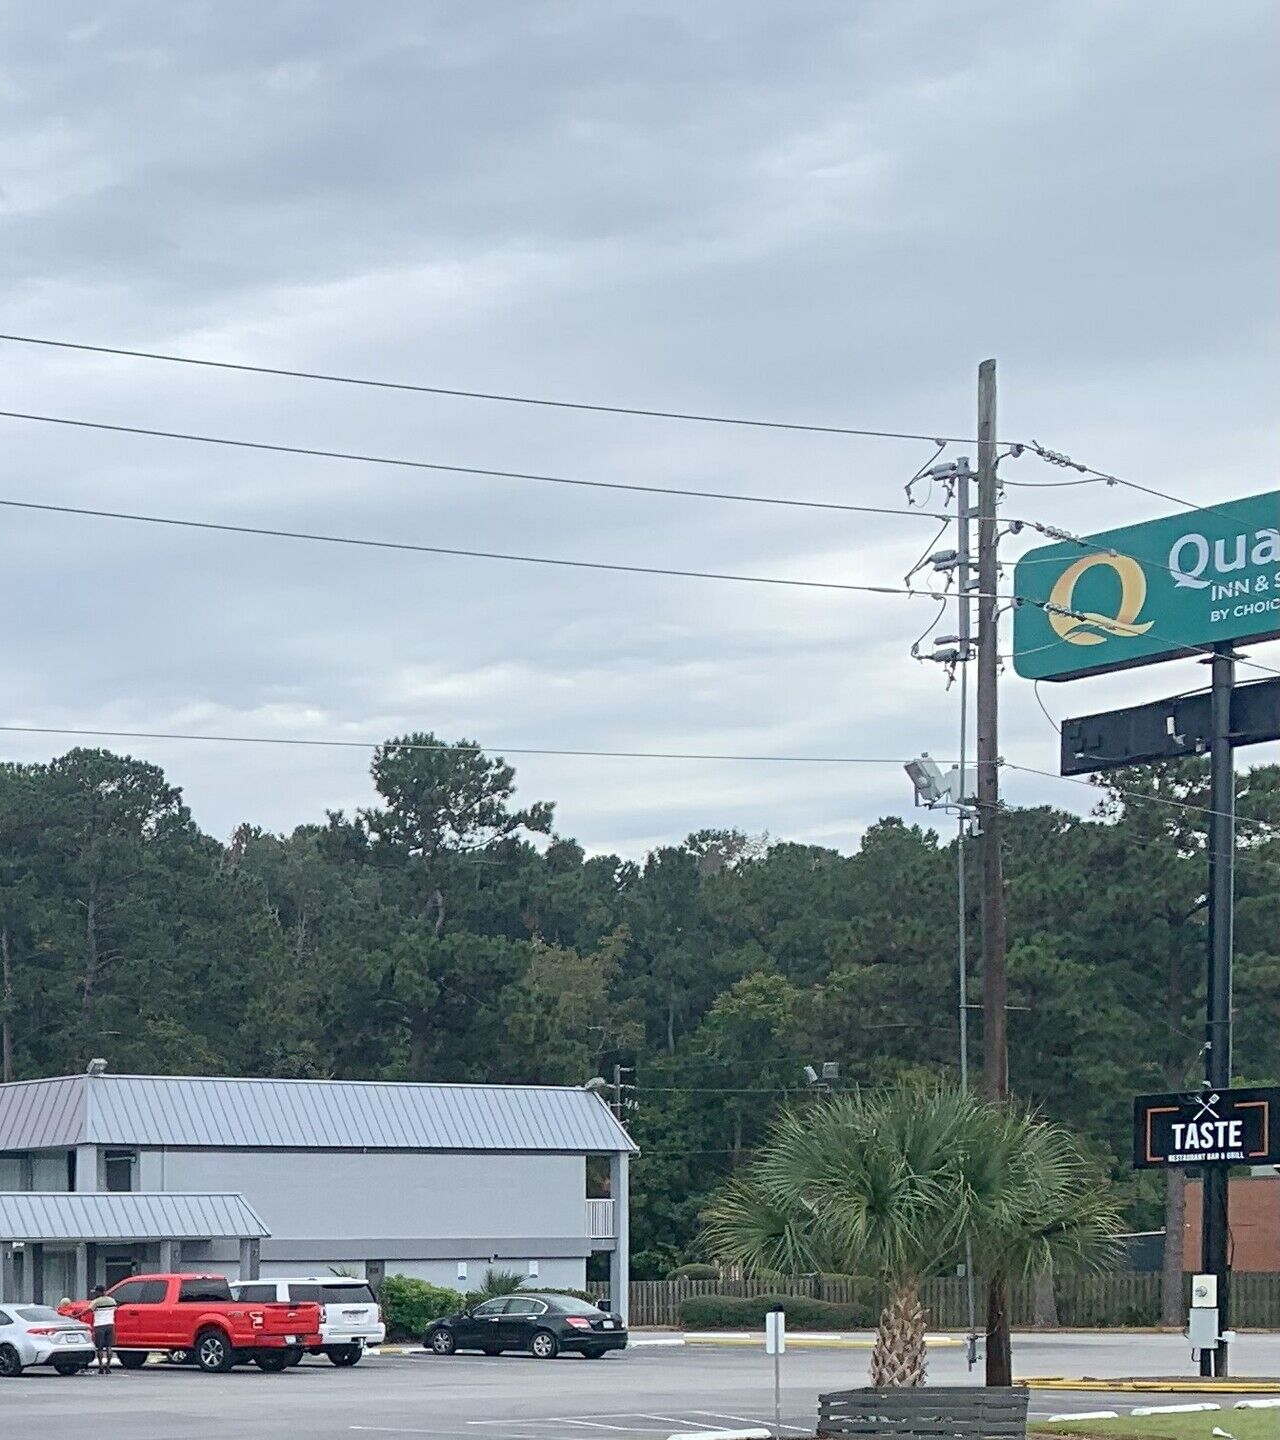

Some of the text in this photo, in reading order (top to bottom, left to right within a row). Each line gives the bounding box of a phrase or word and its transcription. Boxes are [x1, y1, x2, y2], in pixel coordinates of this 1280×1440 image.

[1048, 551, 1156, 647] Q
[1211, 578, 1250, 602] INN
[1254, 575, 1269, 593] &
[1210, 608, 1230, 623] BY
[1171, 1120, 1243, 1150] TASTE
